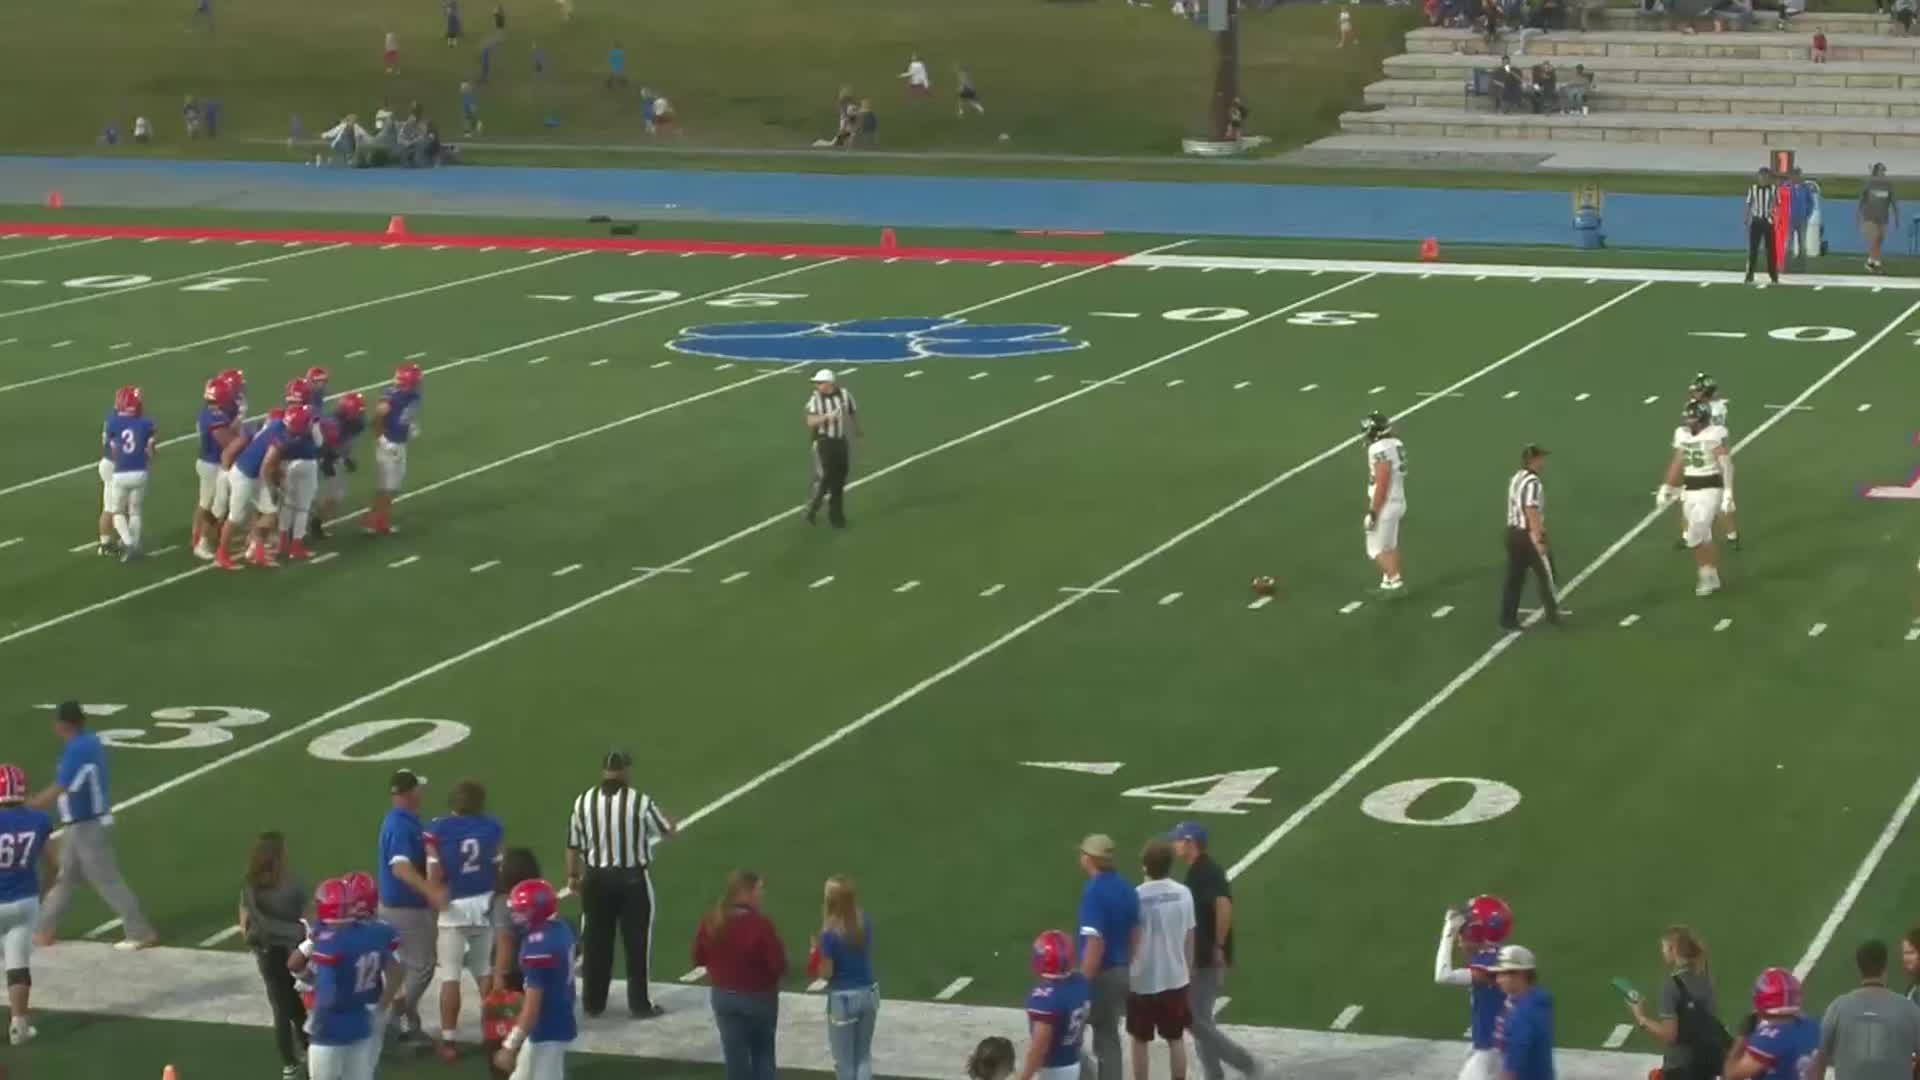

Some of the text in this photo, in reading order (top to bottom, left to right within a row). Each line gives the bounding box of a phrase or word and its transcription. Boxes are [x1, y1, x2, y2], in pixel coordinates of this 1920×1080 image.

[120, 429, 135, 454] 3
[97, 705, 471, 762] 30
[1121, 766, 1522, 826] 40
[0, 831, 36, 868] 67
[461, 838, 480, 874] 2
[354, 951, 380, 993] 12
